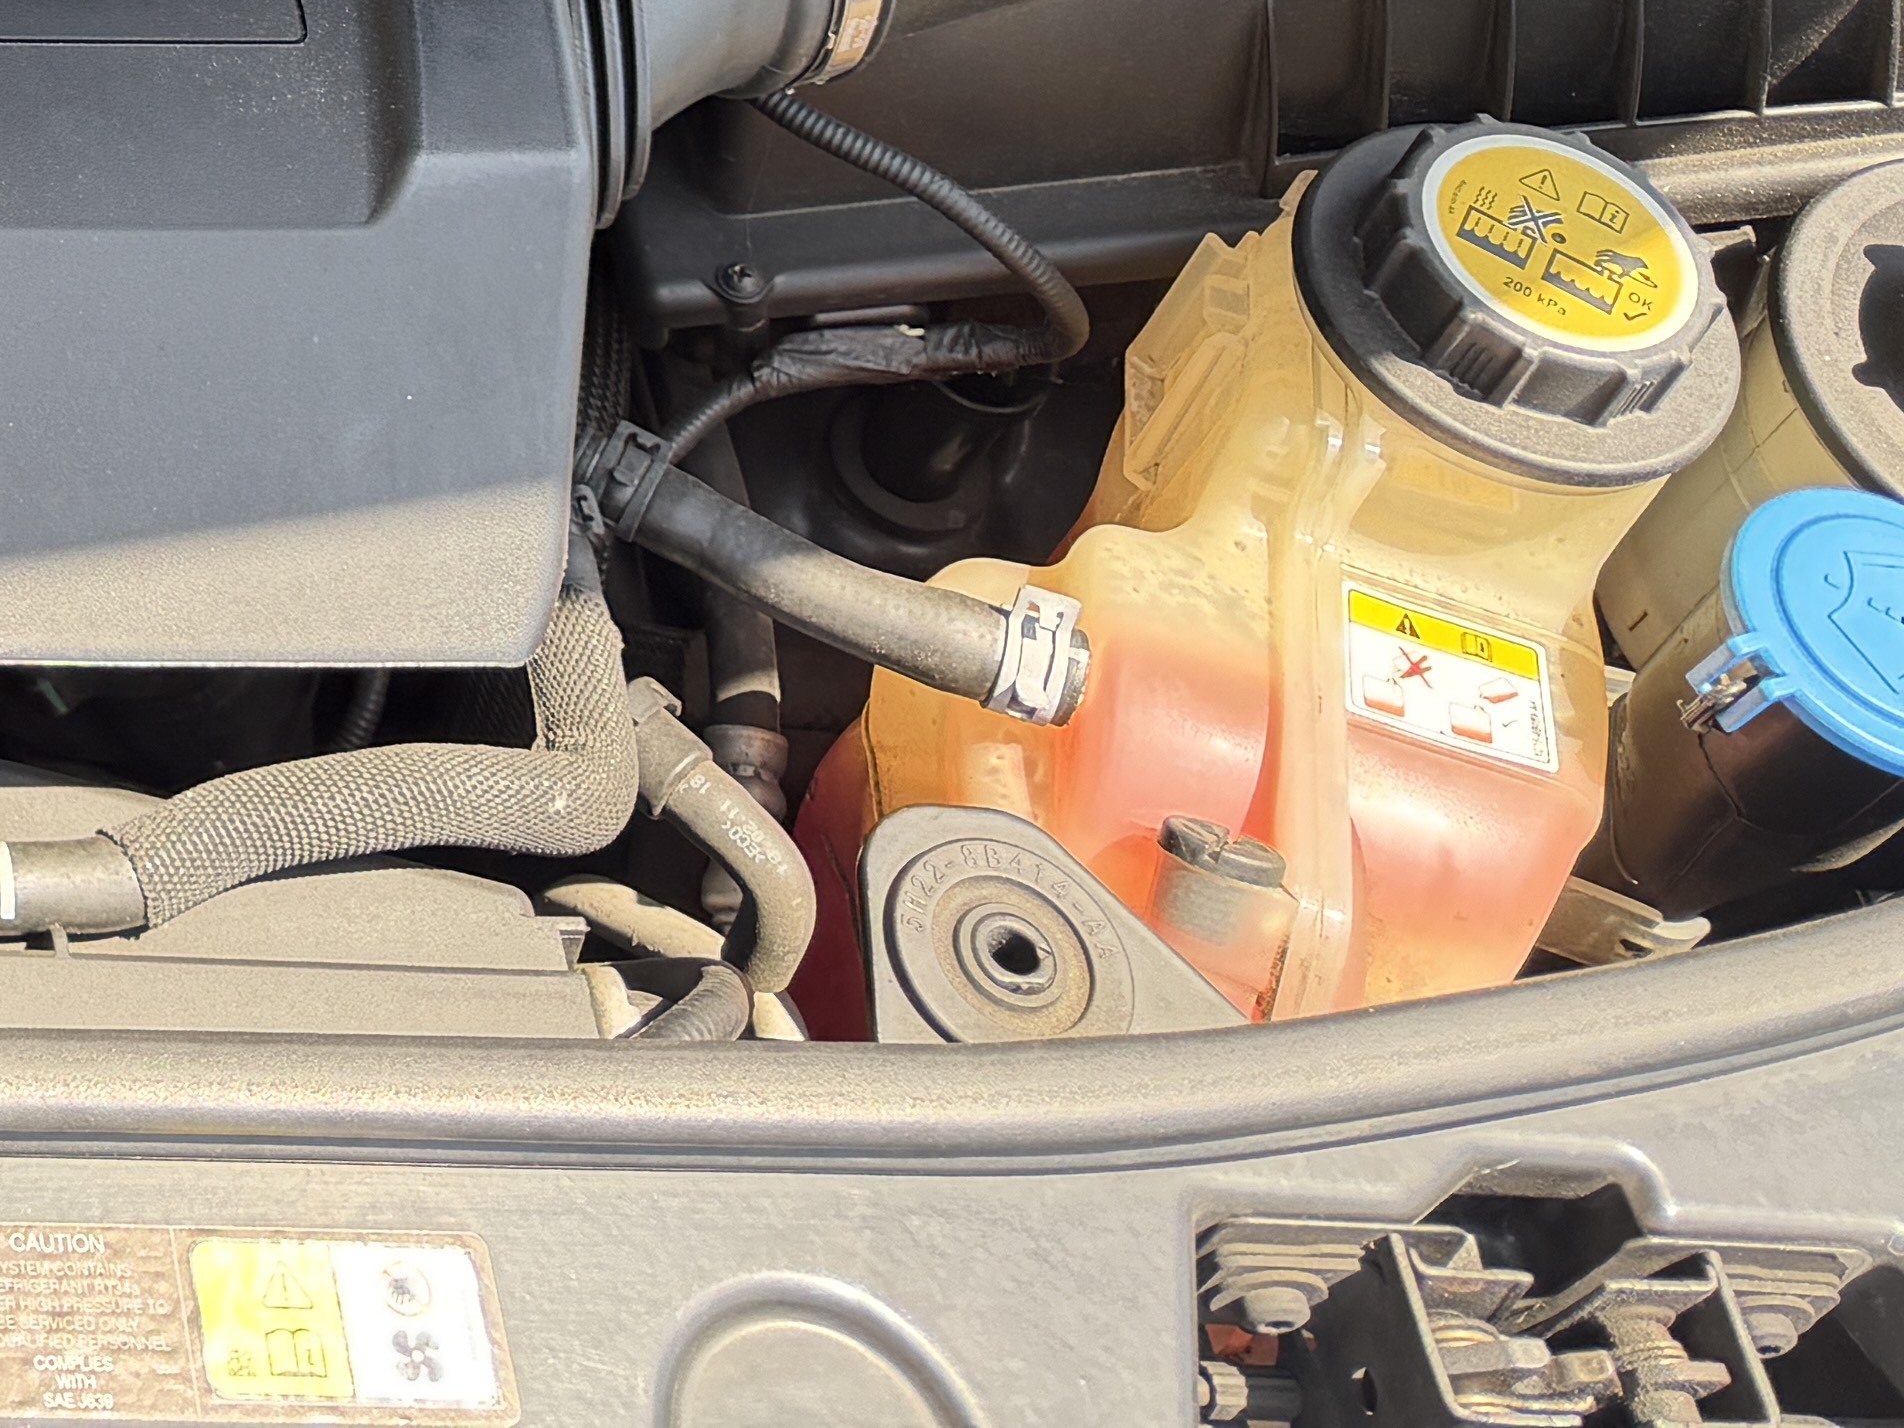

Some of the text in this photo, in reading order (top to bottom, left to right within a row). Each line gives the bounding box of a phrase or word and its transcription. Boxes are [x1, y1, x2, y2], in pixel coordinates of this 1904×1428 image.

[1502, 275, 1567, 317] 200 kPa
[1628, 291, 1654, 313] OK
[8, 1232, 106, 1254] CAUTION
[55, 1261, 133, 1279] CONTAINS
[19, 1296, 61, 1312] HIGH
[62, 1297, 144, 1314] PRESSURE
[146, 1299, 170, 1316] TO
[19, 1315, 96, 1331] SERVICED
[98, 1317, 141, 1334] ONLY
[77, 1334, 173, 1352] PERSONNEL
[32, 1354, 115, 1373] COMPLIES
[54, 1373, 98, 1391] WITH
[42, 1391, 75, 1409] SAE
